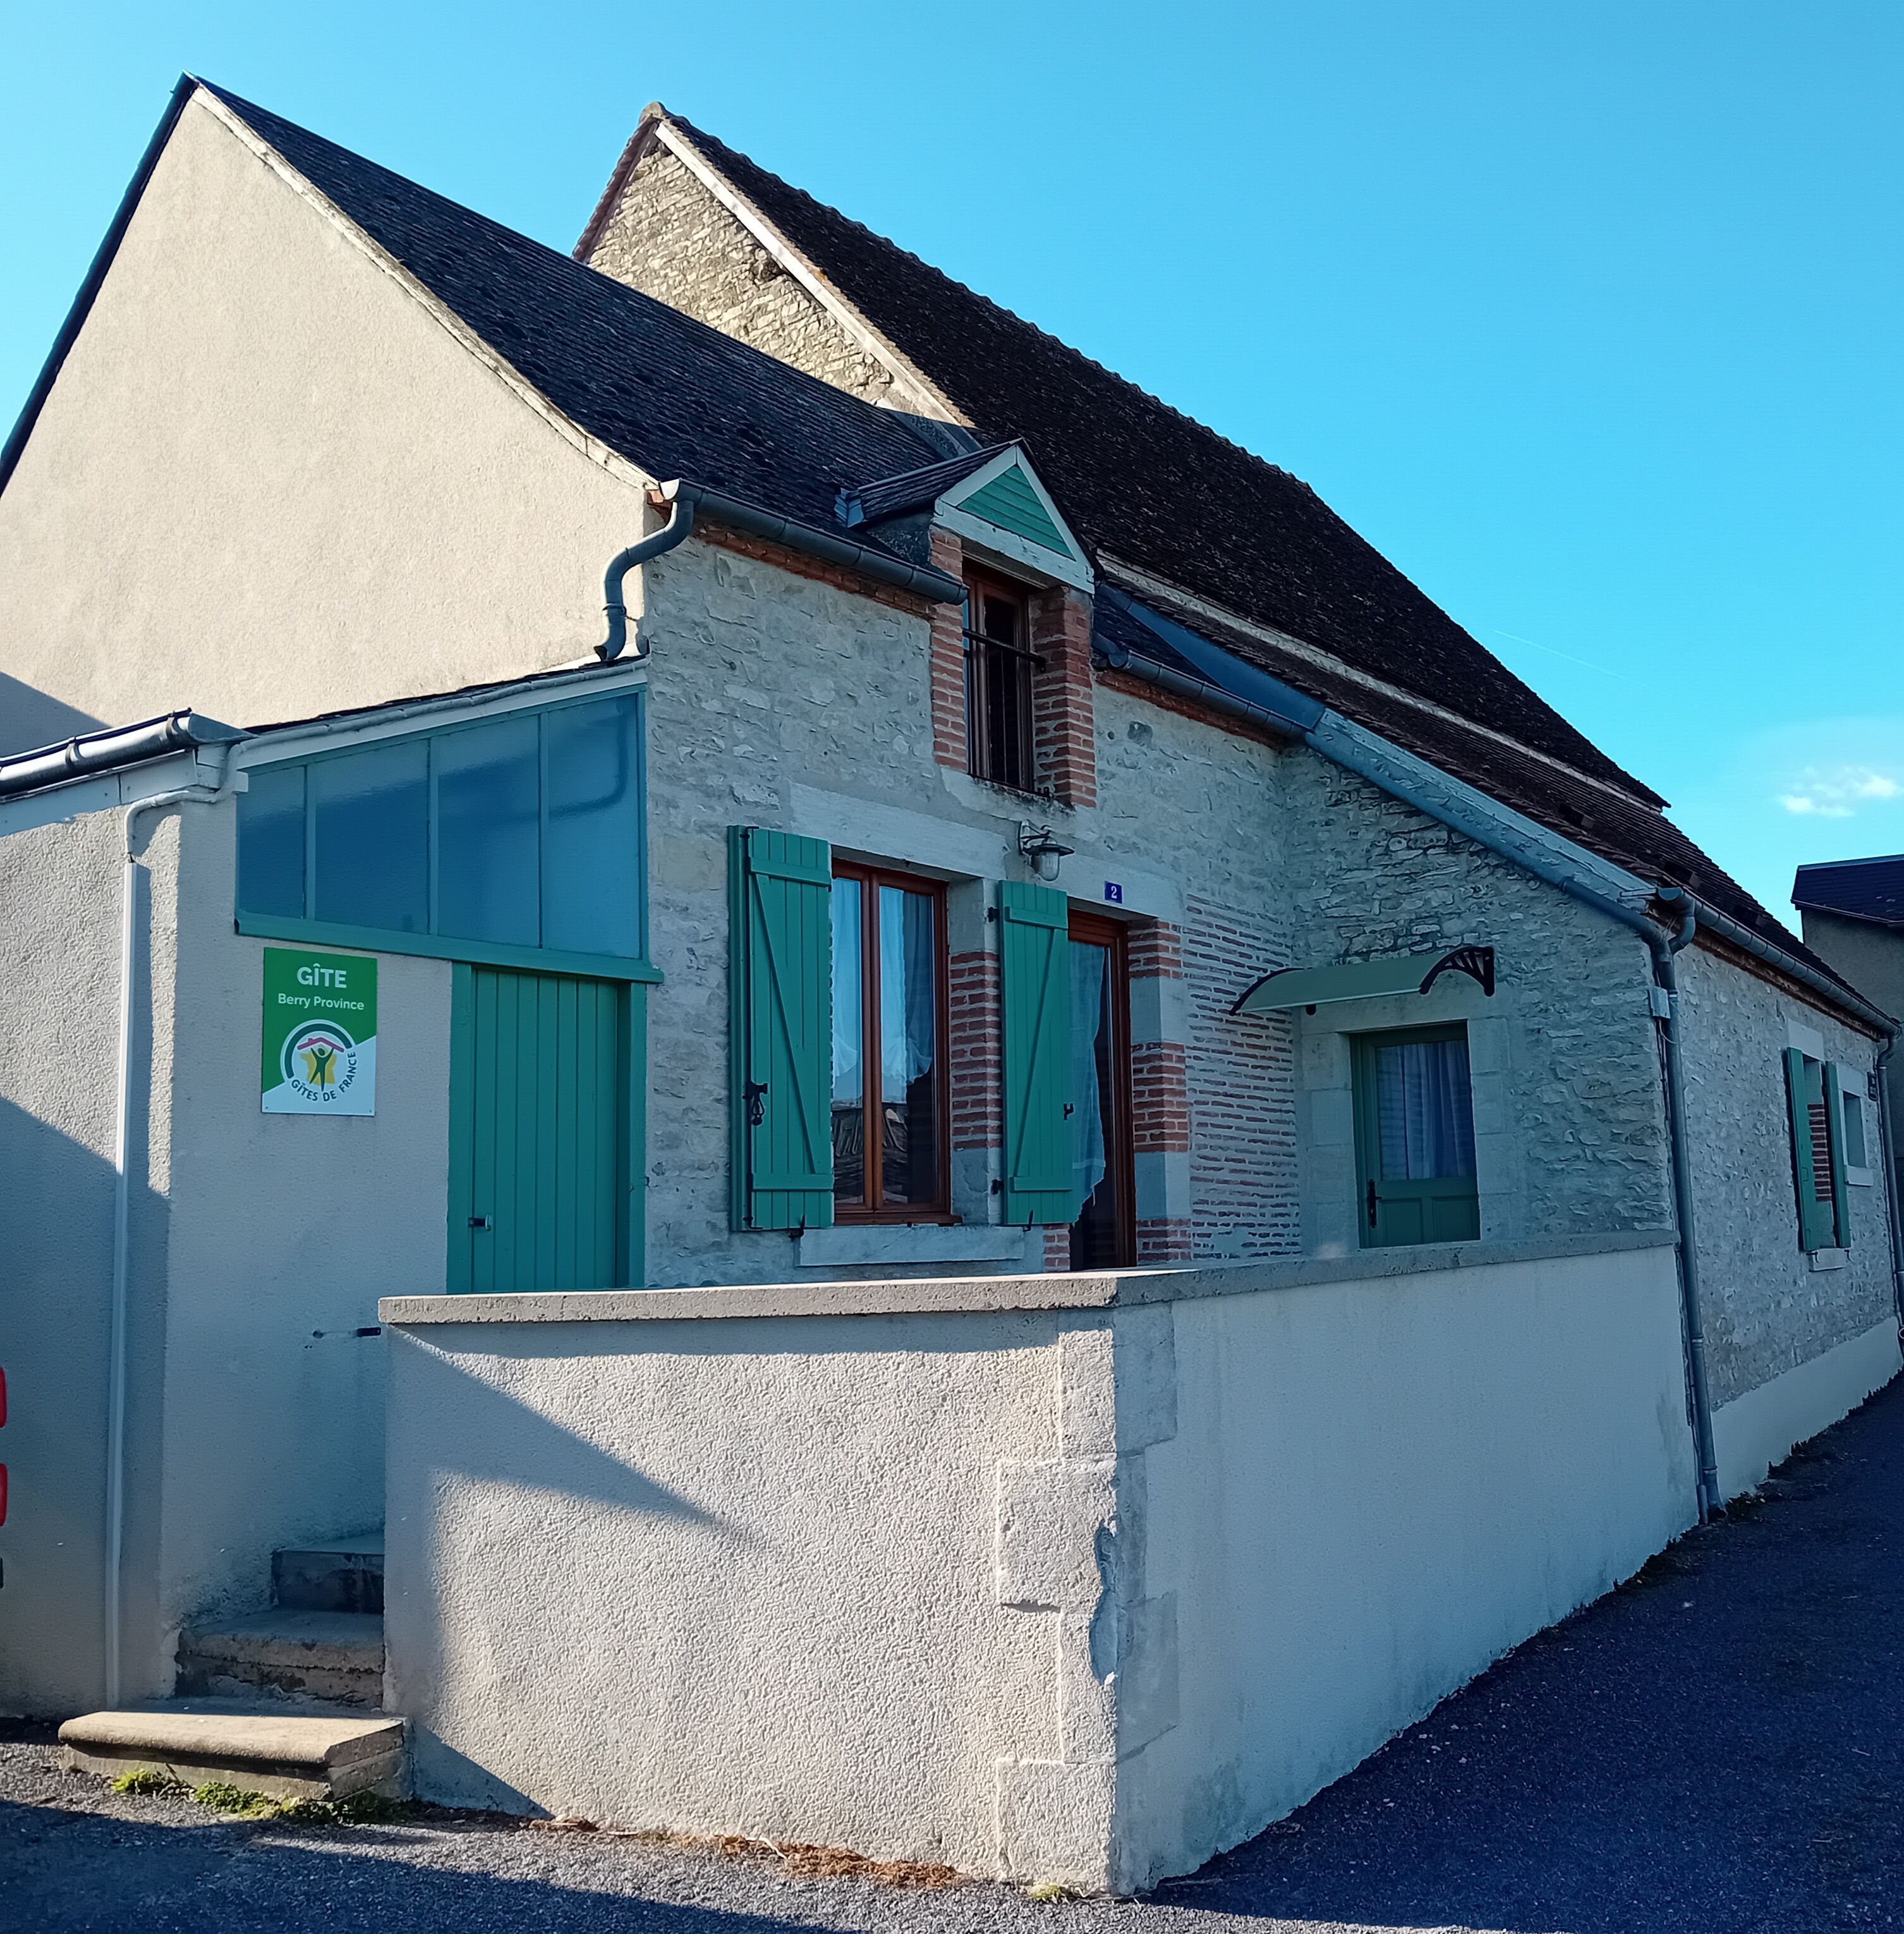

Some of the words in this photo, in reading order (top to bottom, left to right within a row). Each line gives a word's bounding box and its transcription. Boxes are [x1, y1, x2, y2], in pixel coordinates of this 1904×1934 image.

[1111, 885, 1117, 899] 2
[297, 963, 347, 988] GÎTE
[278, 993, 310, 1009] Berry
[313, 996, 365, 1010] Province
[291, 1079, 318, 1102] GÎTES
[323, 1091, 337, 1102] DE
[339, 1052, 357, 1093] FRANCE
